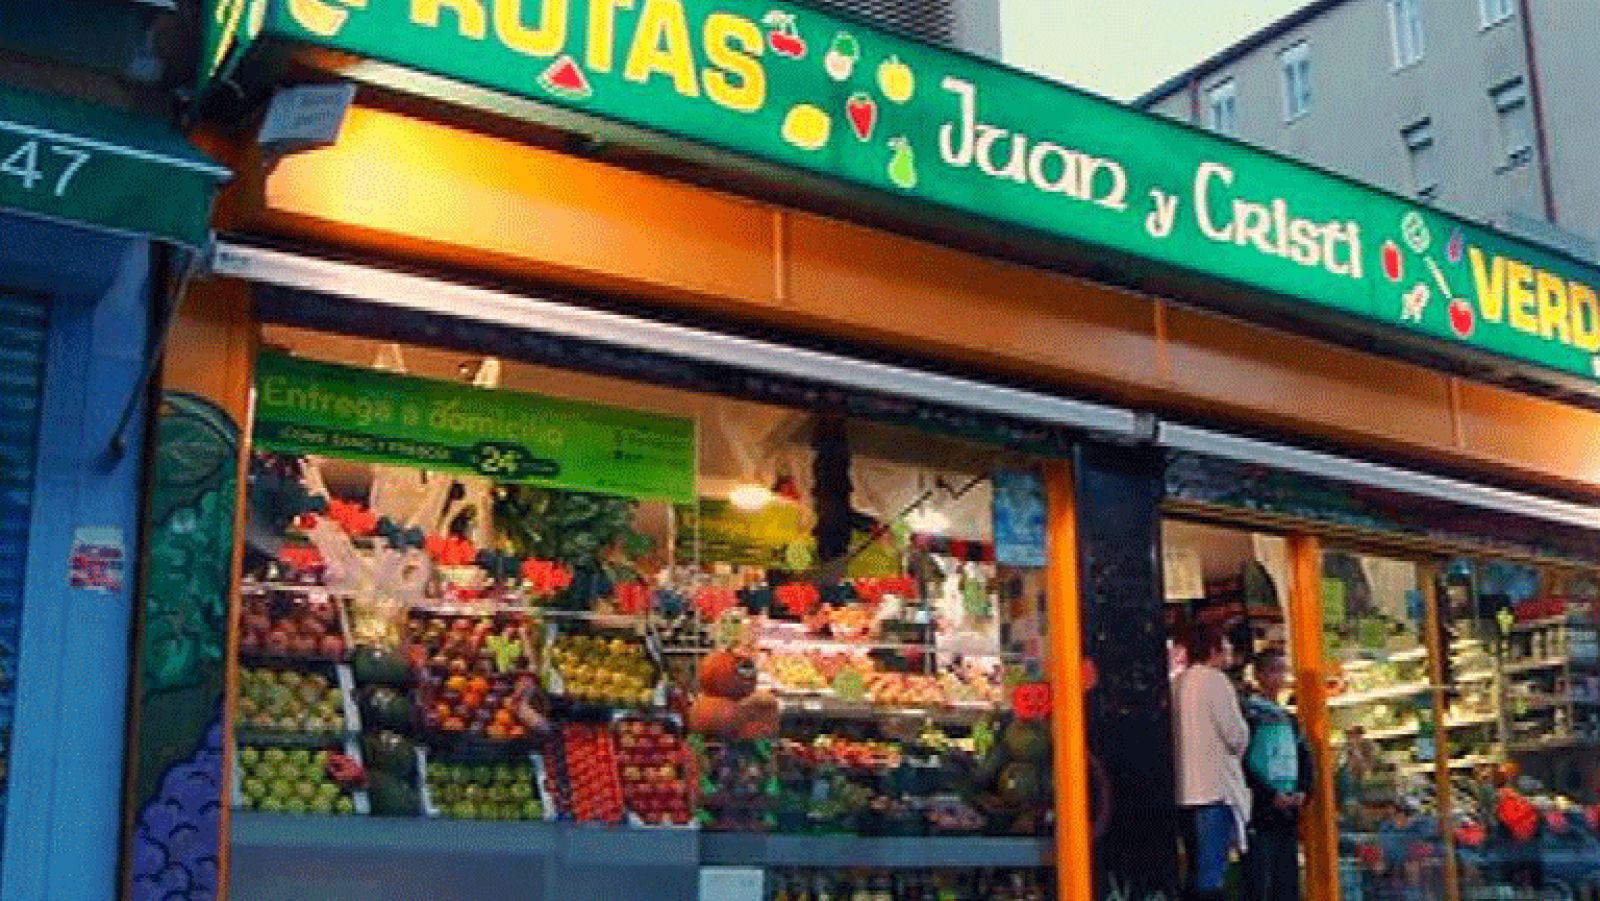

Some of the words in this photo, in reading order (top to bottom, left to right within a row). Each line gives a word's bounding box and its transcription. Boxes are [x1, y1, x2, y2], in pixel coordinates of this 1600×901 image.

[344, 0, 765, 112] UTAS
[0, 140, 91, 197] 47
[938, 76, 1128, 212] Juan
[1144, 188, 1179, 237] y
